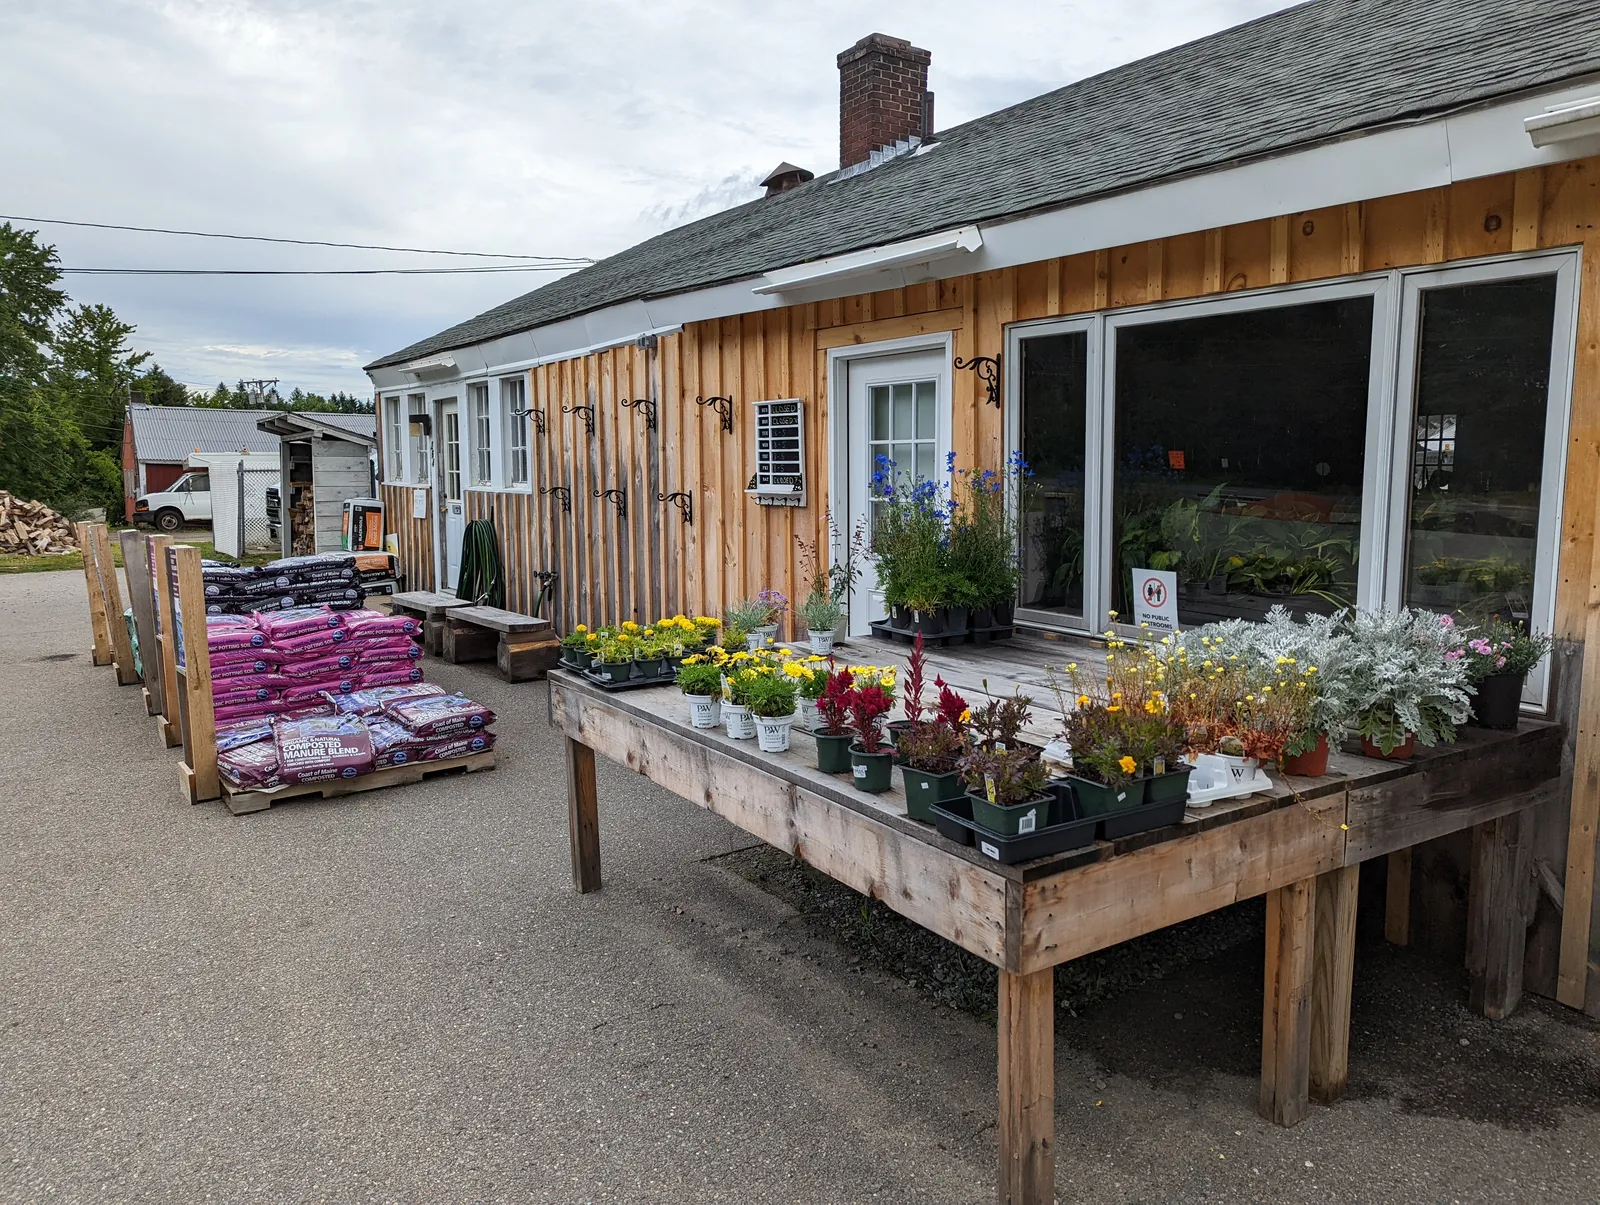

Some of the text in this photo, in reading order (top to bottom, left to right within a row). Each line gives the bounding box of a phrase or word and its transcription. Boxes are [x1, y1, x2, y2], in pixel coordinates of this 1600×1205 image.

[772, 404, 796, 414] CLOSED
[276, 630, 298, 638] ORGANIC
[303, 641, 323, 650] POTTING
[310, 666, 329, 675] POTTING
[697, 705, 713, 713] PW
[436, 722, 464, 732] COMPOSTED
[764, 726, 780, 734] PW
[282, 738, 309, 746] ORGANIC
[283, 741, 341, 751] COMPOSTED
[284, 748, 328, 759] MANURE
[435, 746, 448, 754] Coast
[439, 746, 466, 758] COMPOSTED
[298, 770, 315, 778] Coast
[1231, 769, 1244, 777] W
[302, 774, 335, 782] COMPOSTED
